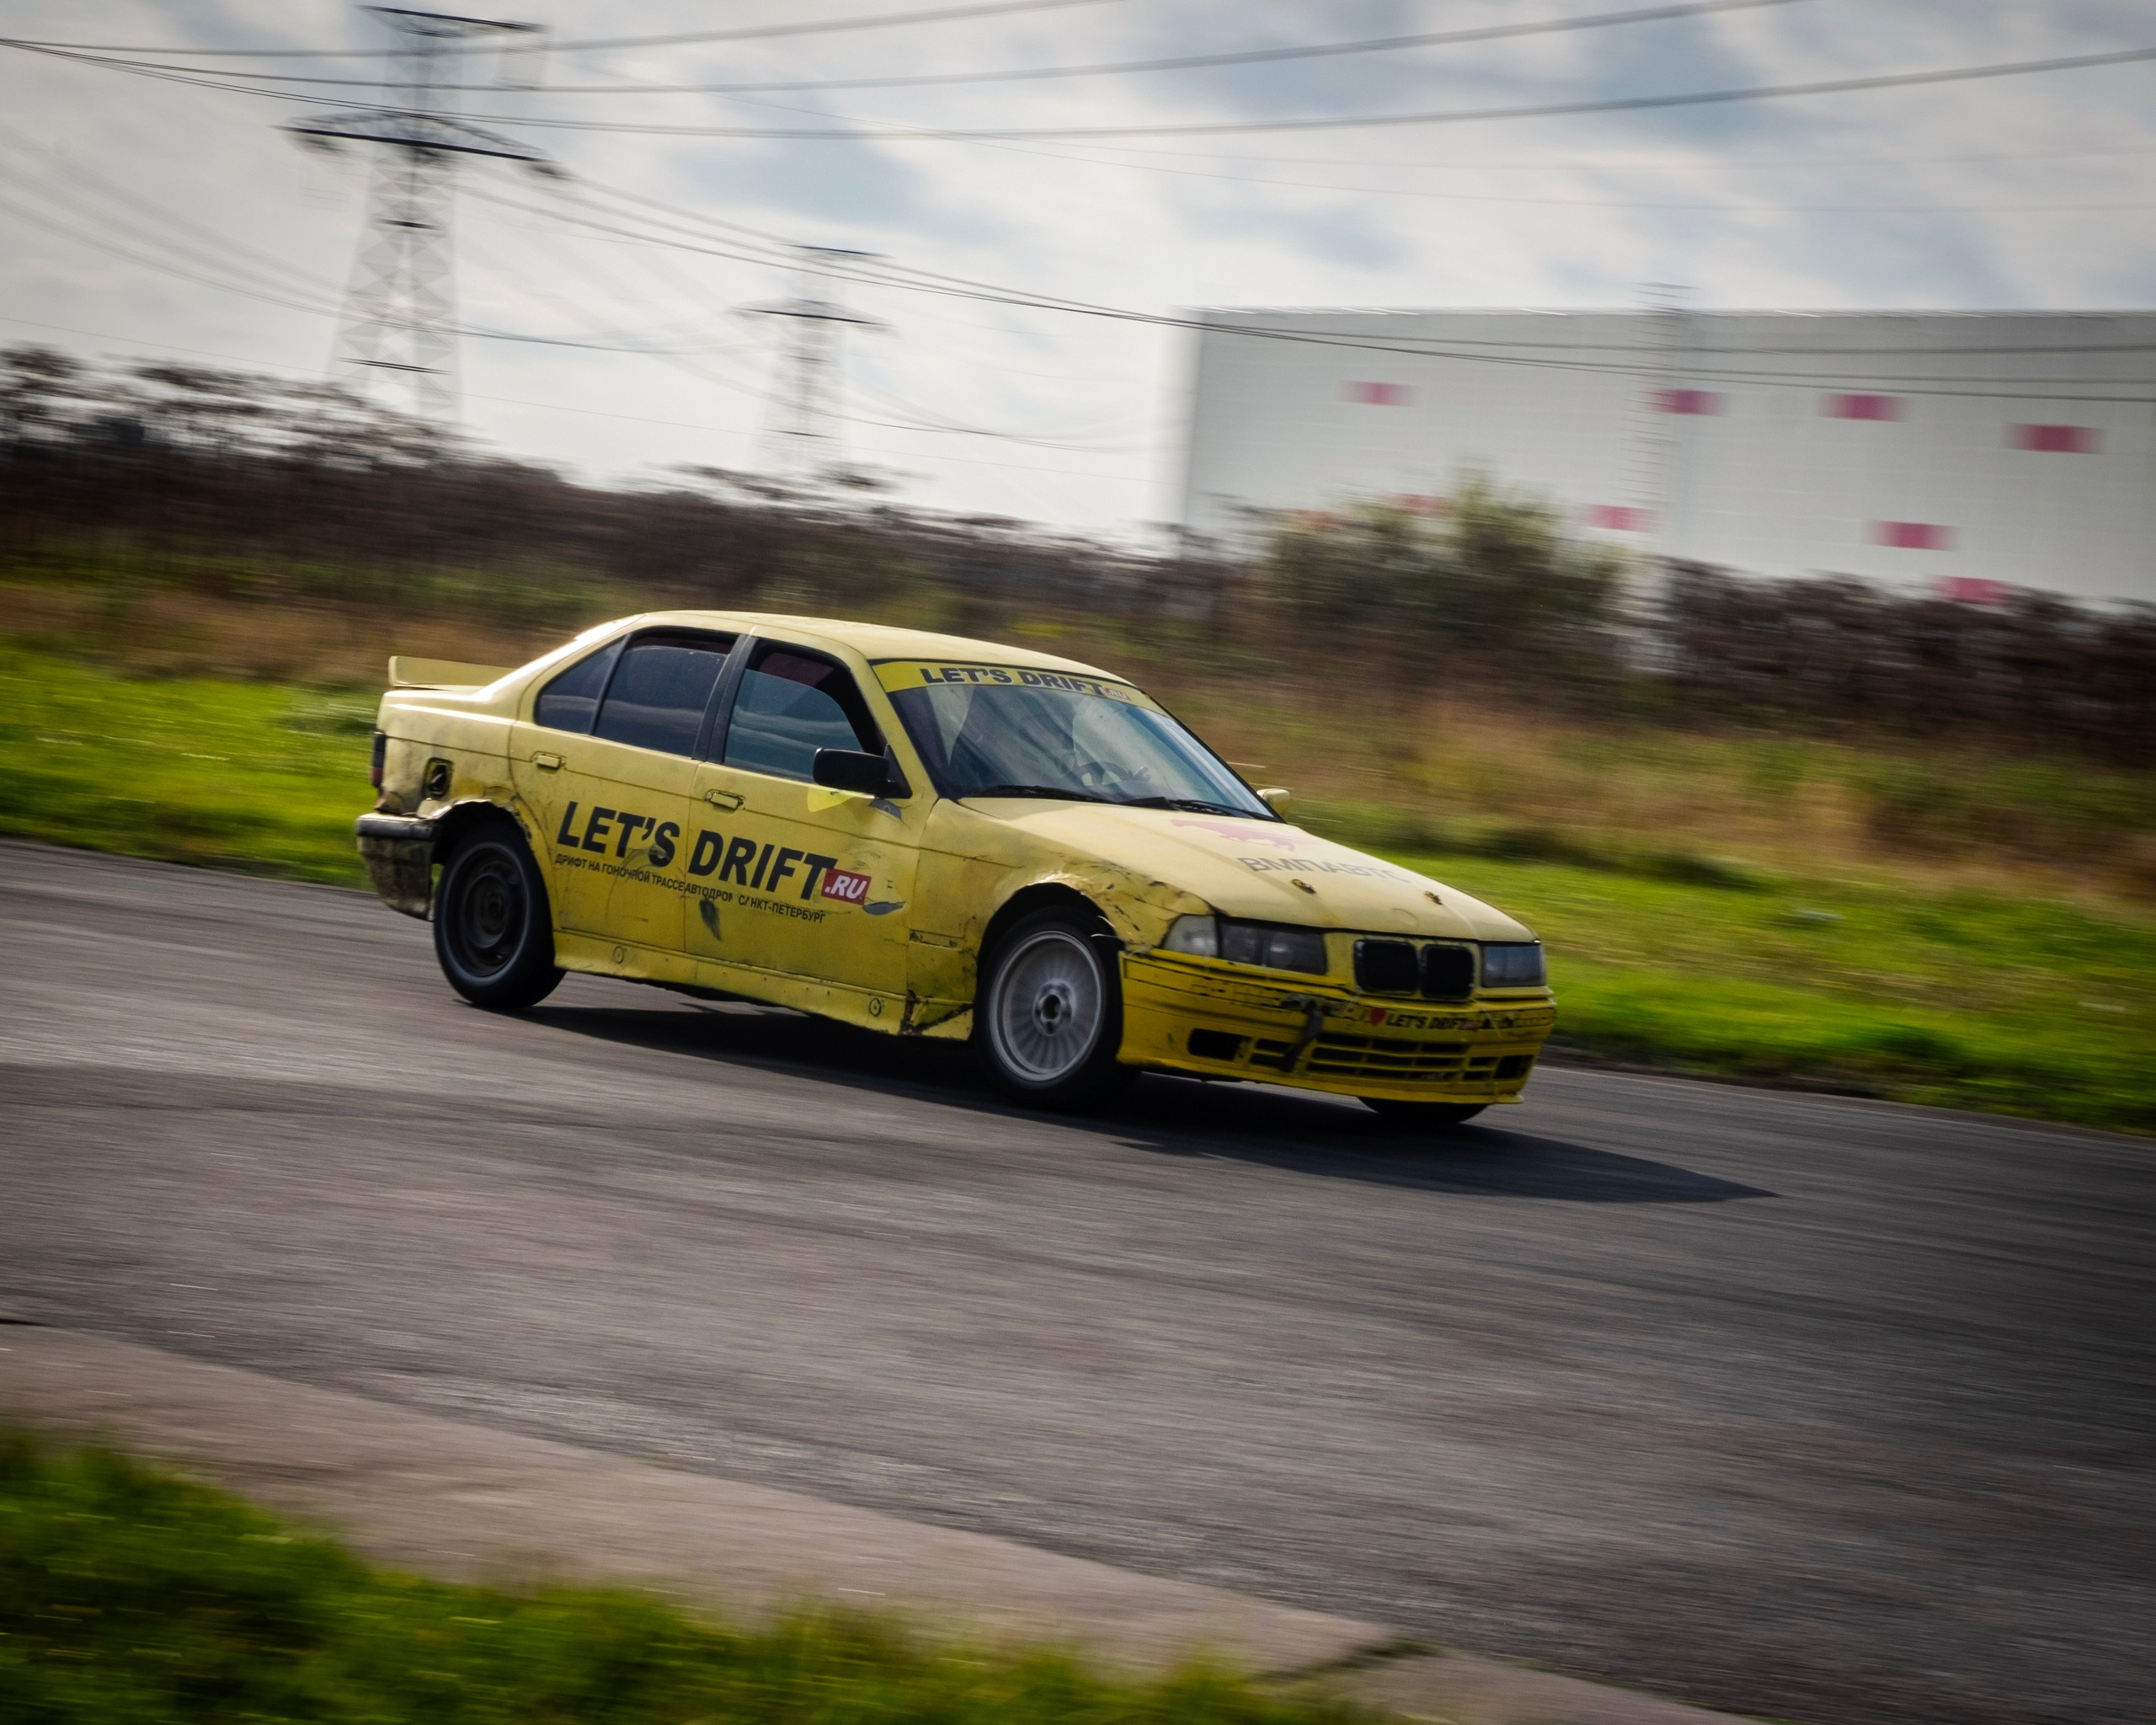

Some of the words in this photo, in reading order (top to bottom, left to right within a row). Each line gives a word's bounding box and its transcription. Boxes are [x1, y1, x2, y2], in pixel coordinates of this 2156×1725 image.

[920, 668, 1012, 684] LET'S
[556, 800, 680, 868] LET'S
[554, 852, 588, 868] ДРИФТ
[588, 861, 601, 872] НА
[651, 874, 685, 891] ТРАССЕ
